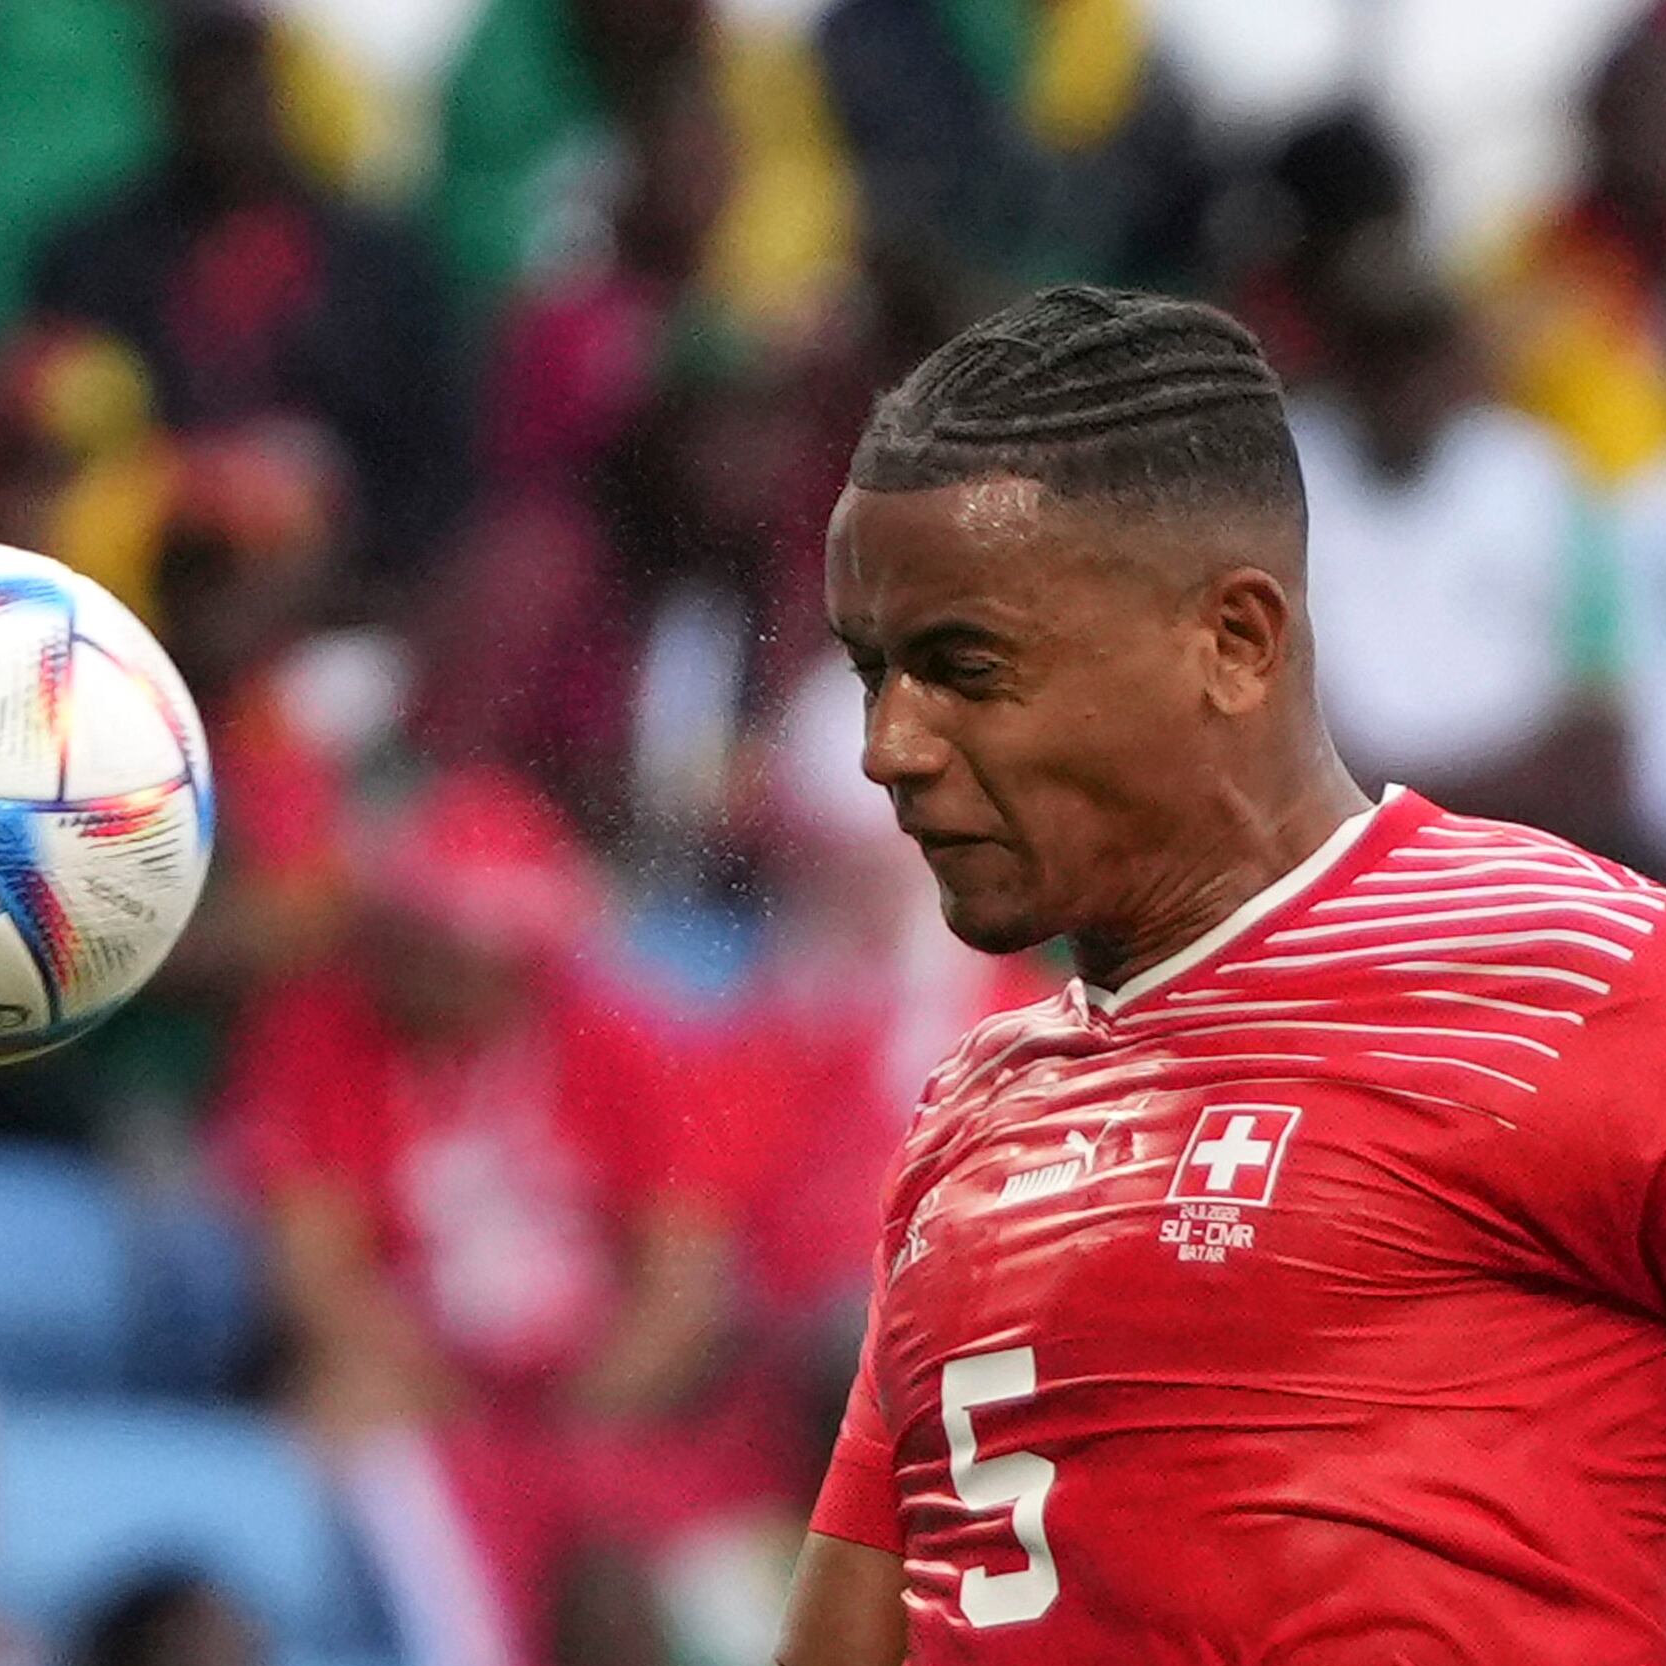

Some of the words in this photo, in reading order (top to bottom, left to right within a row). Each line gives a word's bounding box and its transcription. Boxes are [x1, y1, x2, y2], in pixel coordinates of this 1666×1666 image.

[1158, 1219, 1192, 1242] SUI
[1204, 1222, 1254, 1248] CMR
[1177, 1243, 1226, 1263] QATAR
[942, 1346, 1059, 1628] 5
